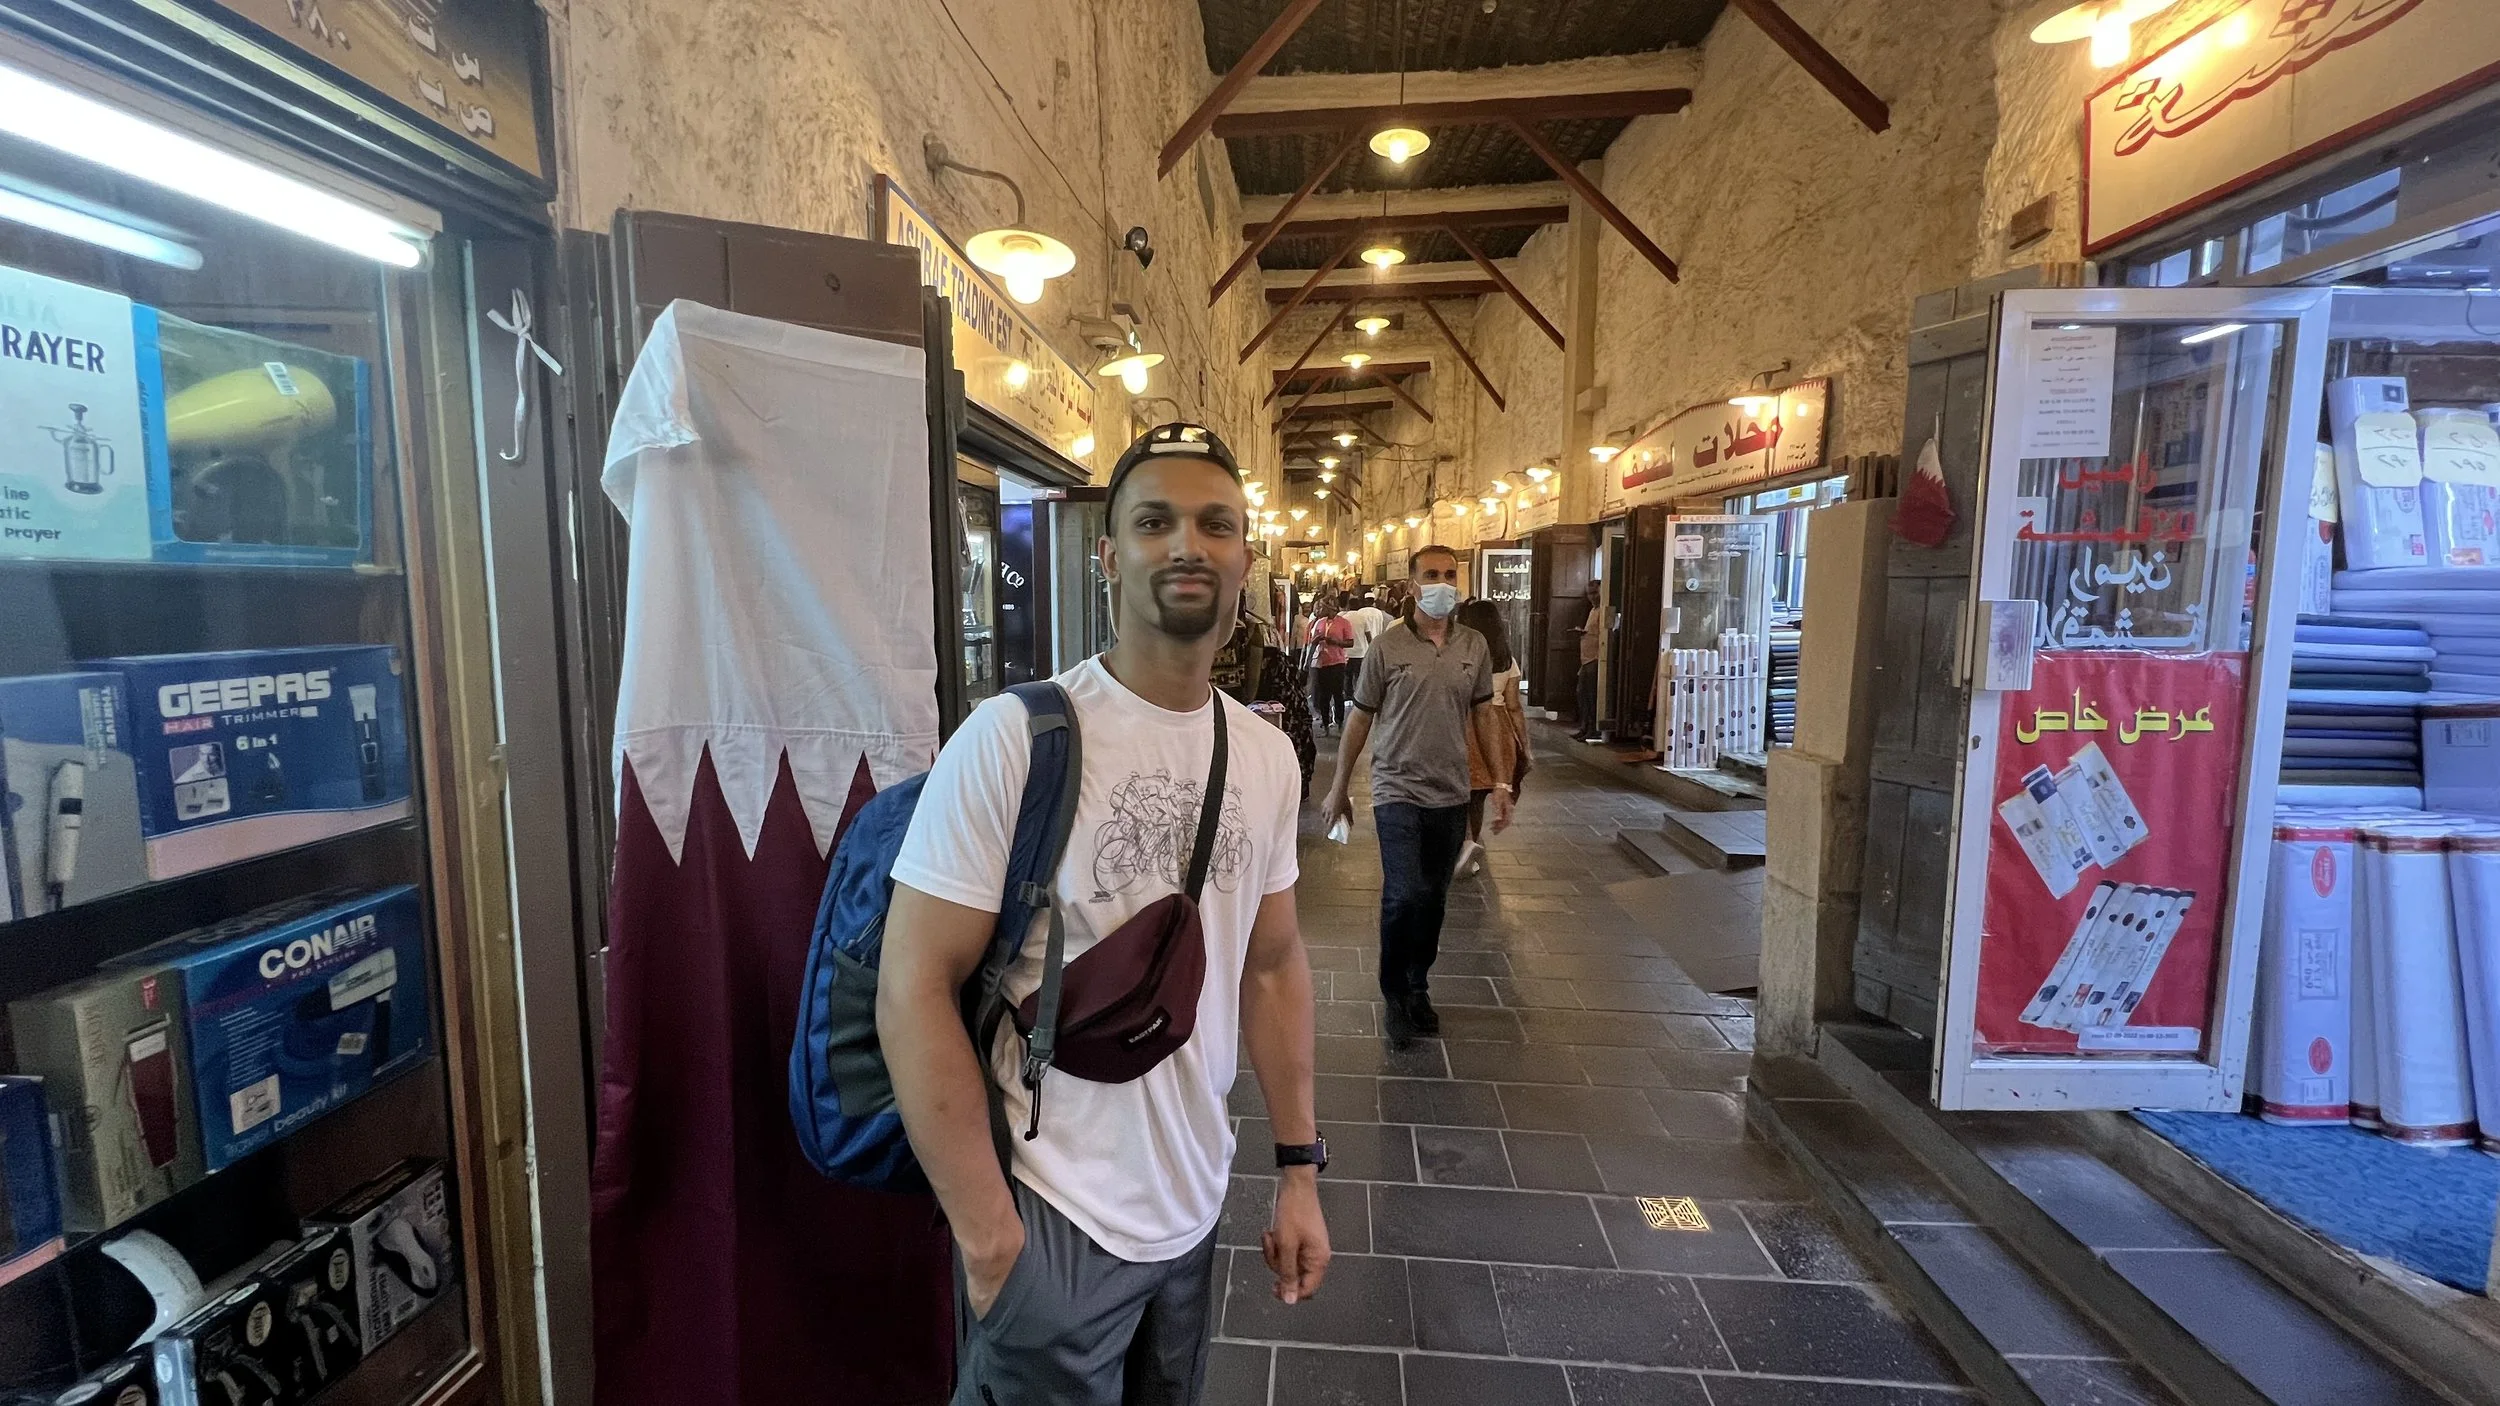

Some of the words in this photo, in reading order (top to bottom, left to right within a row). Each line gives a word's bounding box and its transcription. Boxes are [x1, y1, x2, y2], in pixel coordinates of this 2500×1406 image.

[951, 262, 994, 343] TRADING
[996, 306, 1013, 353] EST
[1, 323, 106, 374] RAYER
[1692, 416, 1783, 469] محلات
[1494, 559, 1530, 578] لعميد
[158, 670, 332, 718] GEEPAS
[221, 707, 301, 726] TRIMMER
[2016, 686, 2109, 744] خاص
[2119, 701, 2215, 744] عرض
[258, 914, 378, 979] CONAIR
[1127, 1015, 1164, 1044] EASTPAK
